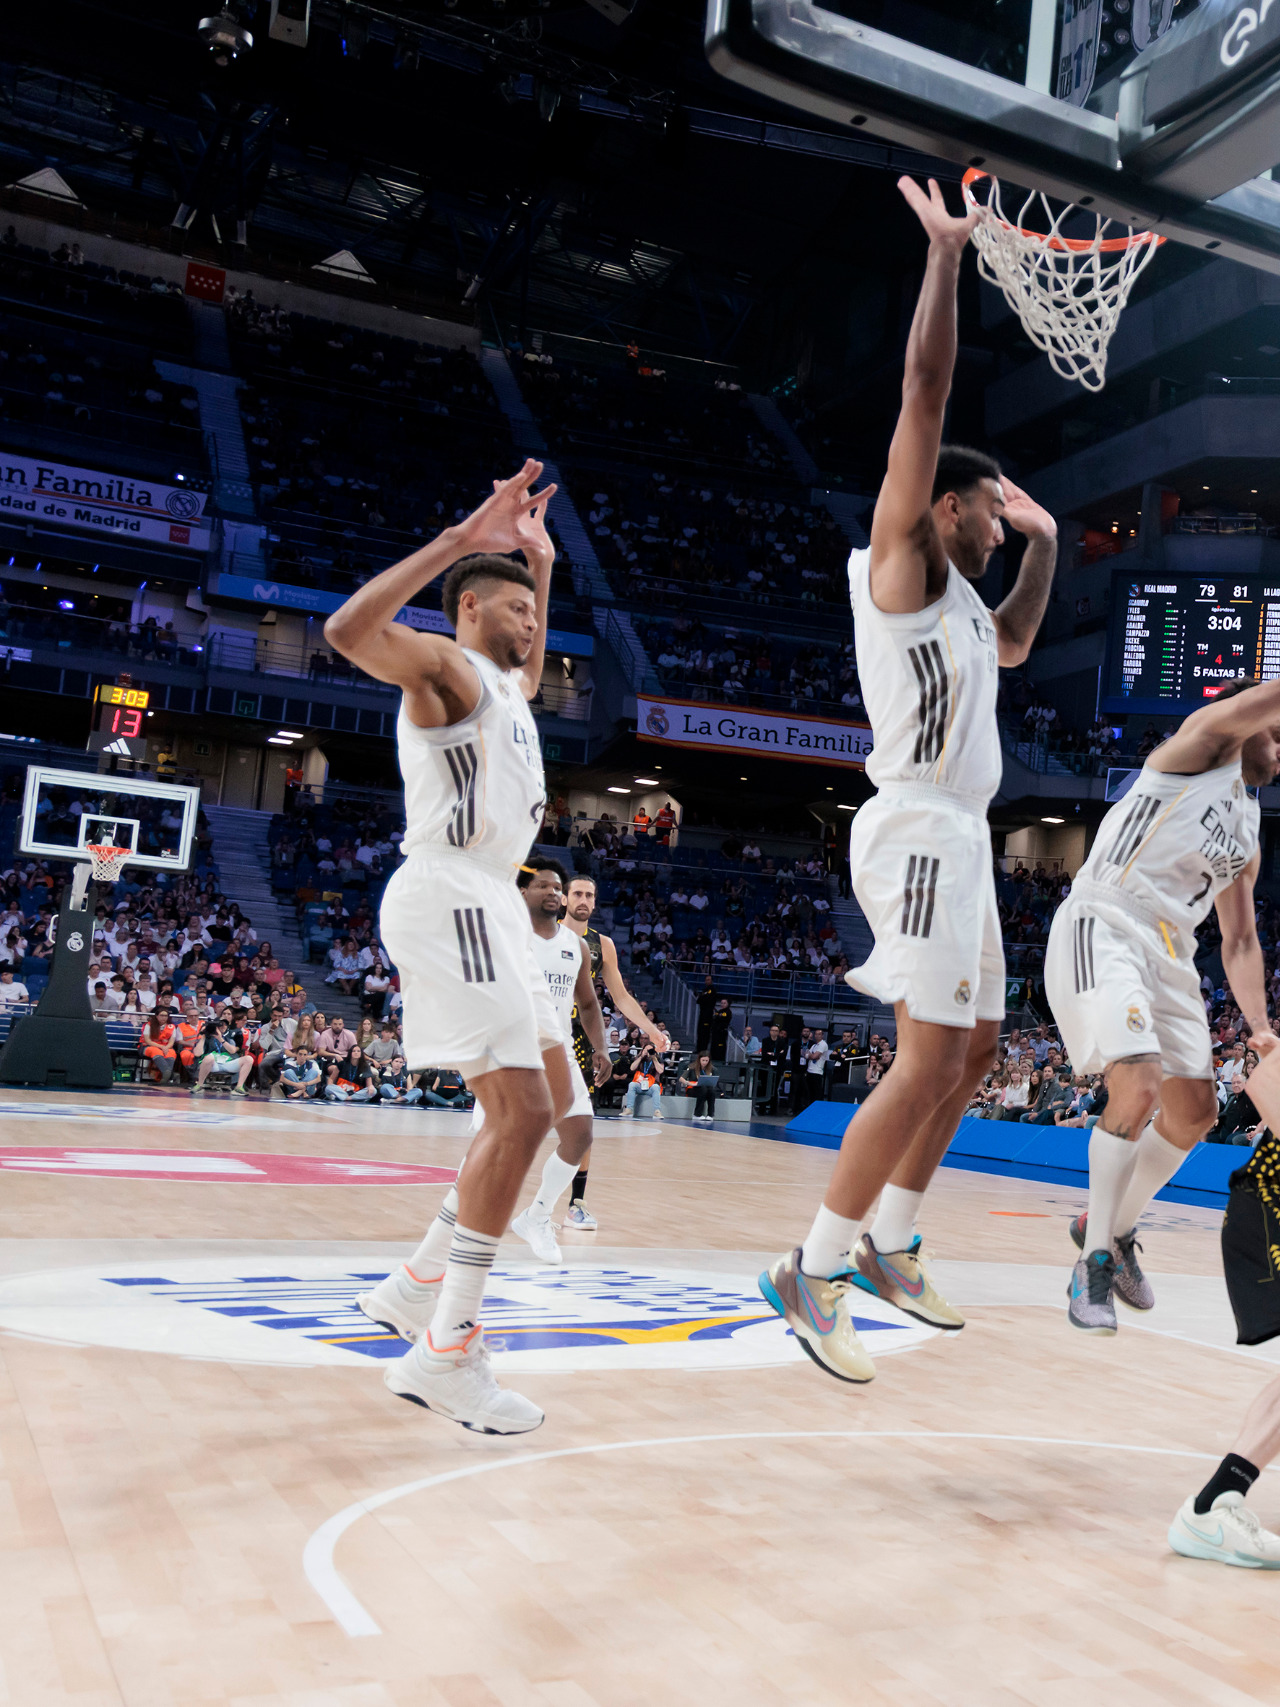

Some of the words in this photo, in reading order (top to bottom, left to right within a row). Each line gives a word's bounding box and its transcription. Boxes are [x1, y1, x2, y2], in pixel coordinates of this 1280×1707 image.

[34, 466, 153, 507] Familia
[43, 504, 67, 518] de
[74, 508, 141, 532] Madrid
[1199, 584, 1216, 597] 79
[1233, 585, 1248, 598] 81
[411, 611, 445, 624] Movistar
[1208, 615, 1242, 631] 3:04
[1197, 643, 1209, 651] TM
[1232, 644, 1244, 652] TM
[1214, 654, 1223, 665] 4
[1193, 666, 1201, 677] 5
[1202, 668, 1235, 678] FALTAS
[1237, 667, 1246, 679] 5
[111, 687, 149, 708] 3:03
[111, 708, 142, 738] 13
[682, 714, 713, 737] La
[717, 718, 779, 744] Gran
[785, 727, 874, 756] Familia
